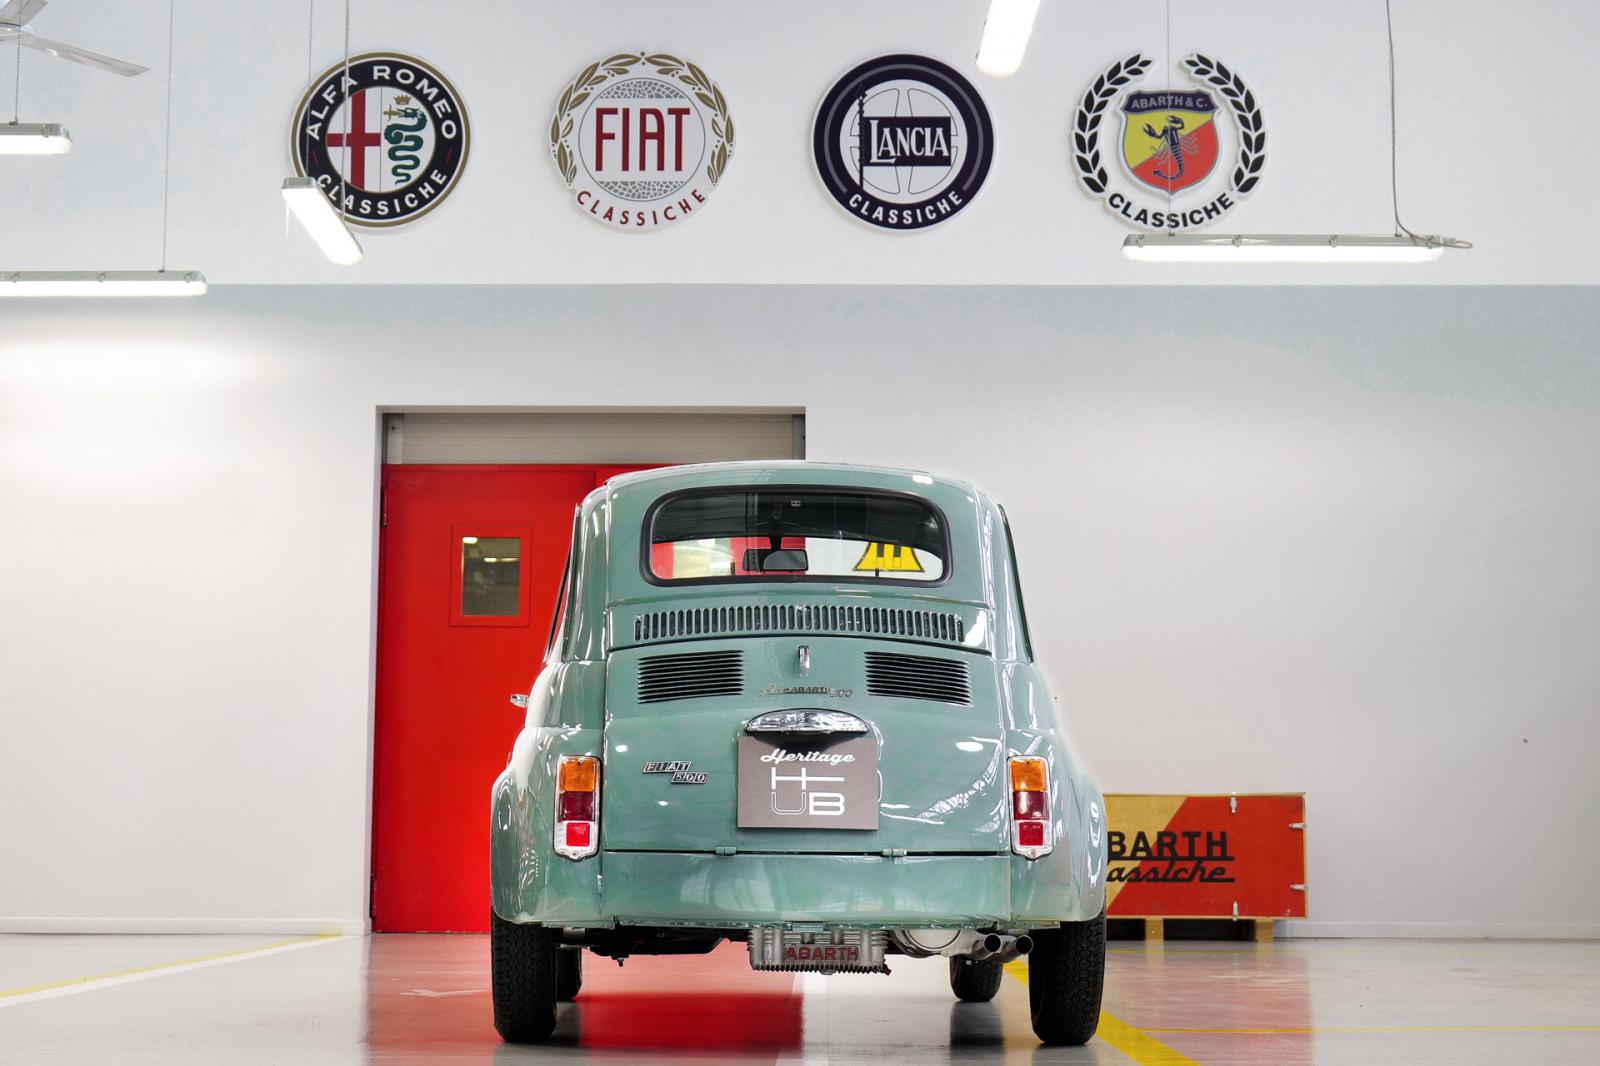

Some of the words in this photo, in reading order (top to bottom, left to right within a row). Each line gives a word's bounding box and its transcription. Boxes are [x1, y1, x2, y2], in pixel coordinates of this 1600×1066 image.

[306, 74, 359, 141] ALFA
[372, 65, 457, 139] ROMEO
[1131, 95, 1183, 109] ABARTH
[1185, 96, 1195, 107] &
[595, 107, 691, 172] FIAT
[869, 119, 950, 164] LANCIA
[316, 168, 448, 216] CLASSICHE
[576, 188, 706, 226] CLASSICHE
[848, 190, 963, 225] CLASSICHE
[1108, 192, 1235, 229] CLASSICHE
[644, 761, 691, 772] FIAT
[760, 748, 856, 764] Heritage
[673, 773, 707, 783] 500
[1107, 831, 1228, 858] BARTH
[784, 946, 859, 961] ABARTH
